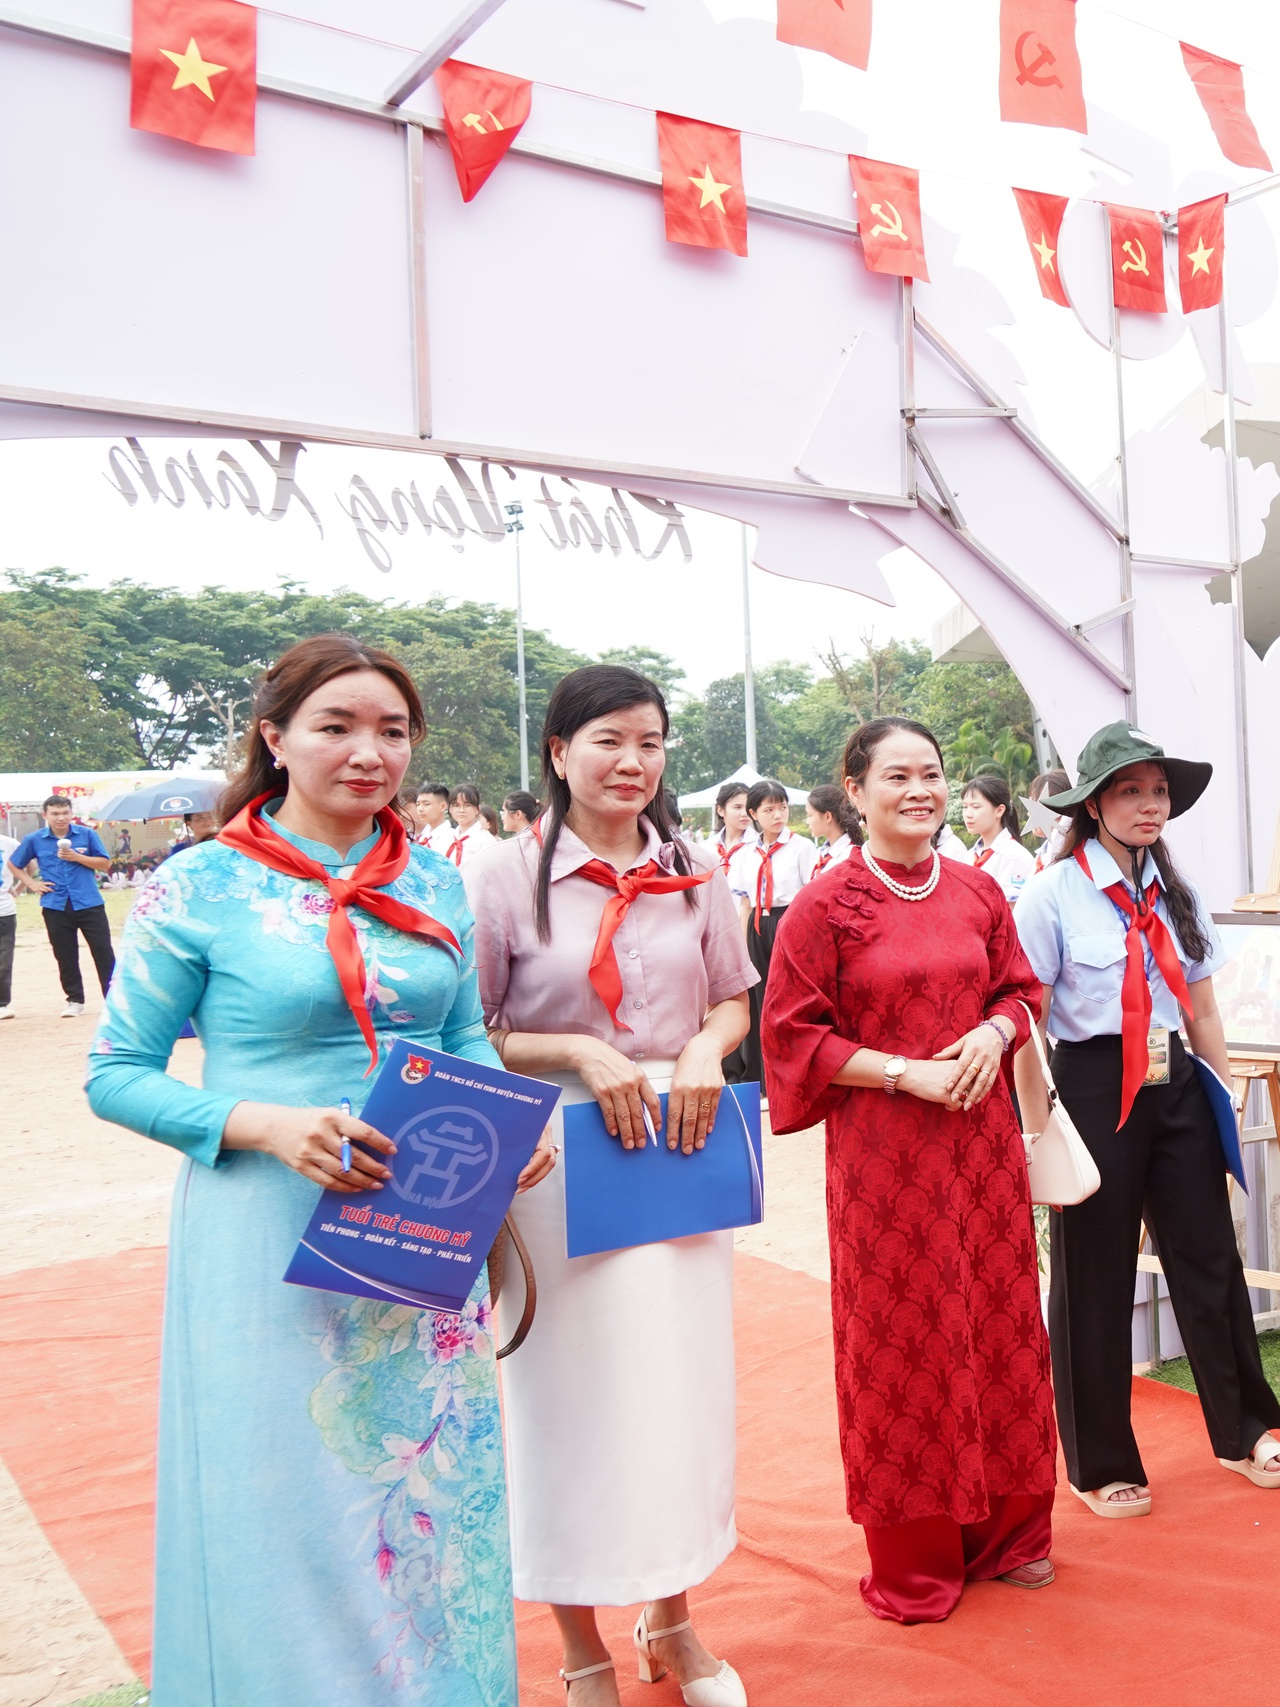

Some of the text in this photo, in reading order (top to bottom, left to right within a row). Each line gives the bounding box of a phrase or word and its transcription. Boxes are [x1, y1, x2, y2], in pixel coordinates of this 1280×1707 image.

[450, 1075, 466, 1085] TNCS
[483, 1084, 497, 1094] MINH
[335, 1226, 361, 1239] PHONG
[364, 1232, 384, 1245] ĐOÀN
[383, 1236, 397, 1247] KẾT
[400, 1241, 420, 1253] SÁNG
[419, 1245, 432, 1256] TẠO
[436, 1249, 454, 1260] PHÁT
[339, 1204, 473, 1248] TUỔI TRẺ CHƯƠNG MỸ
